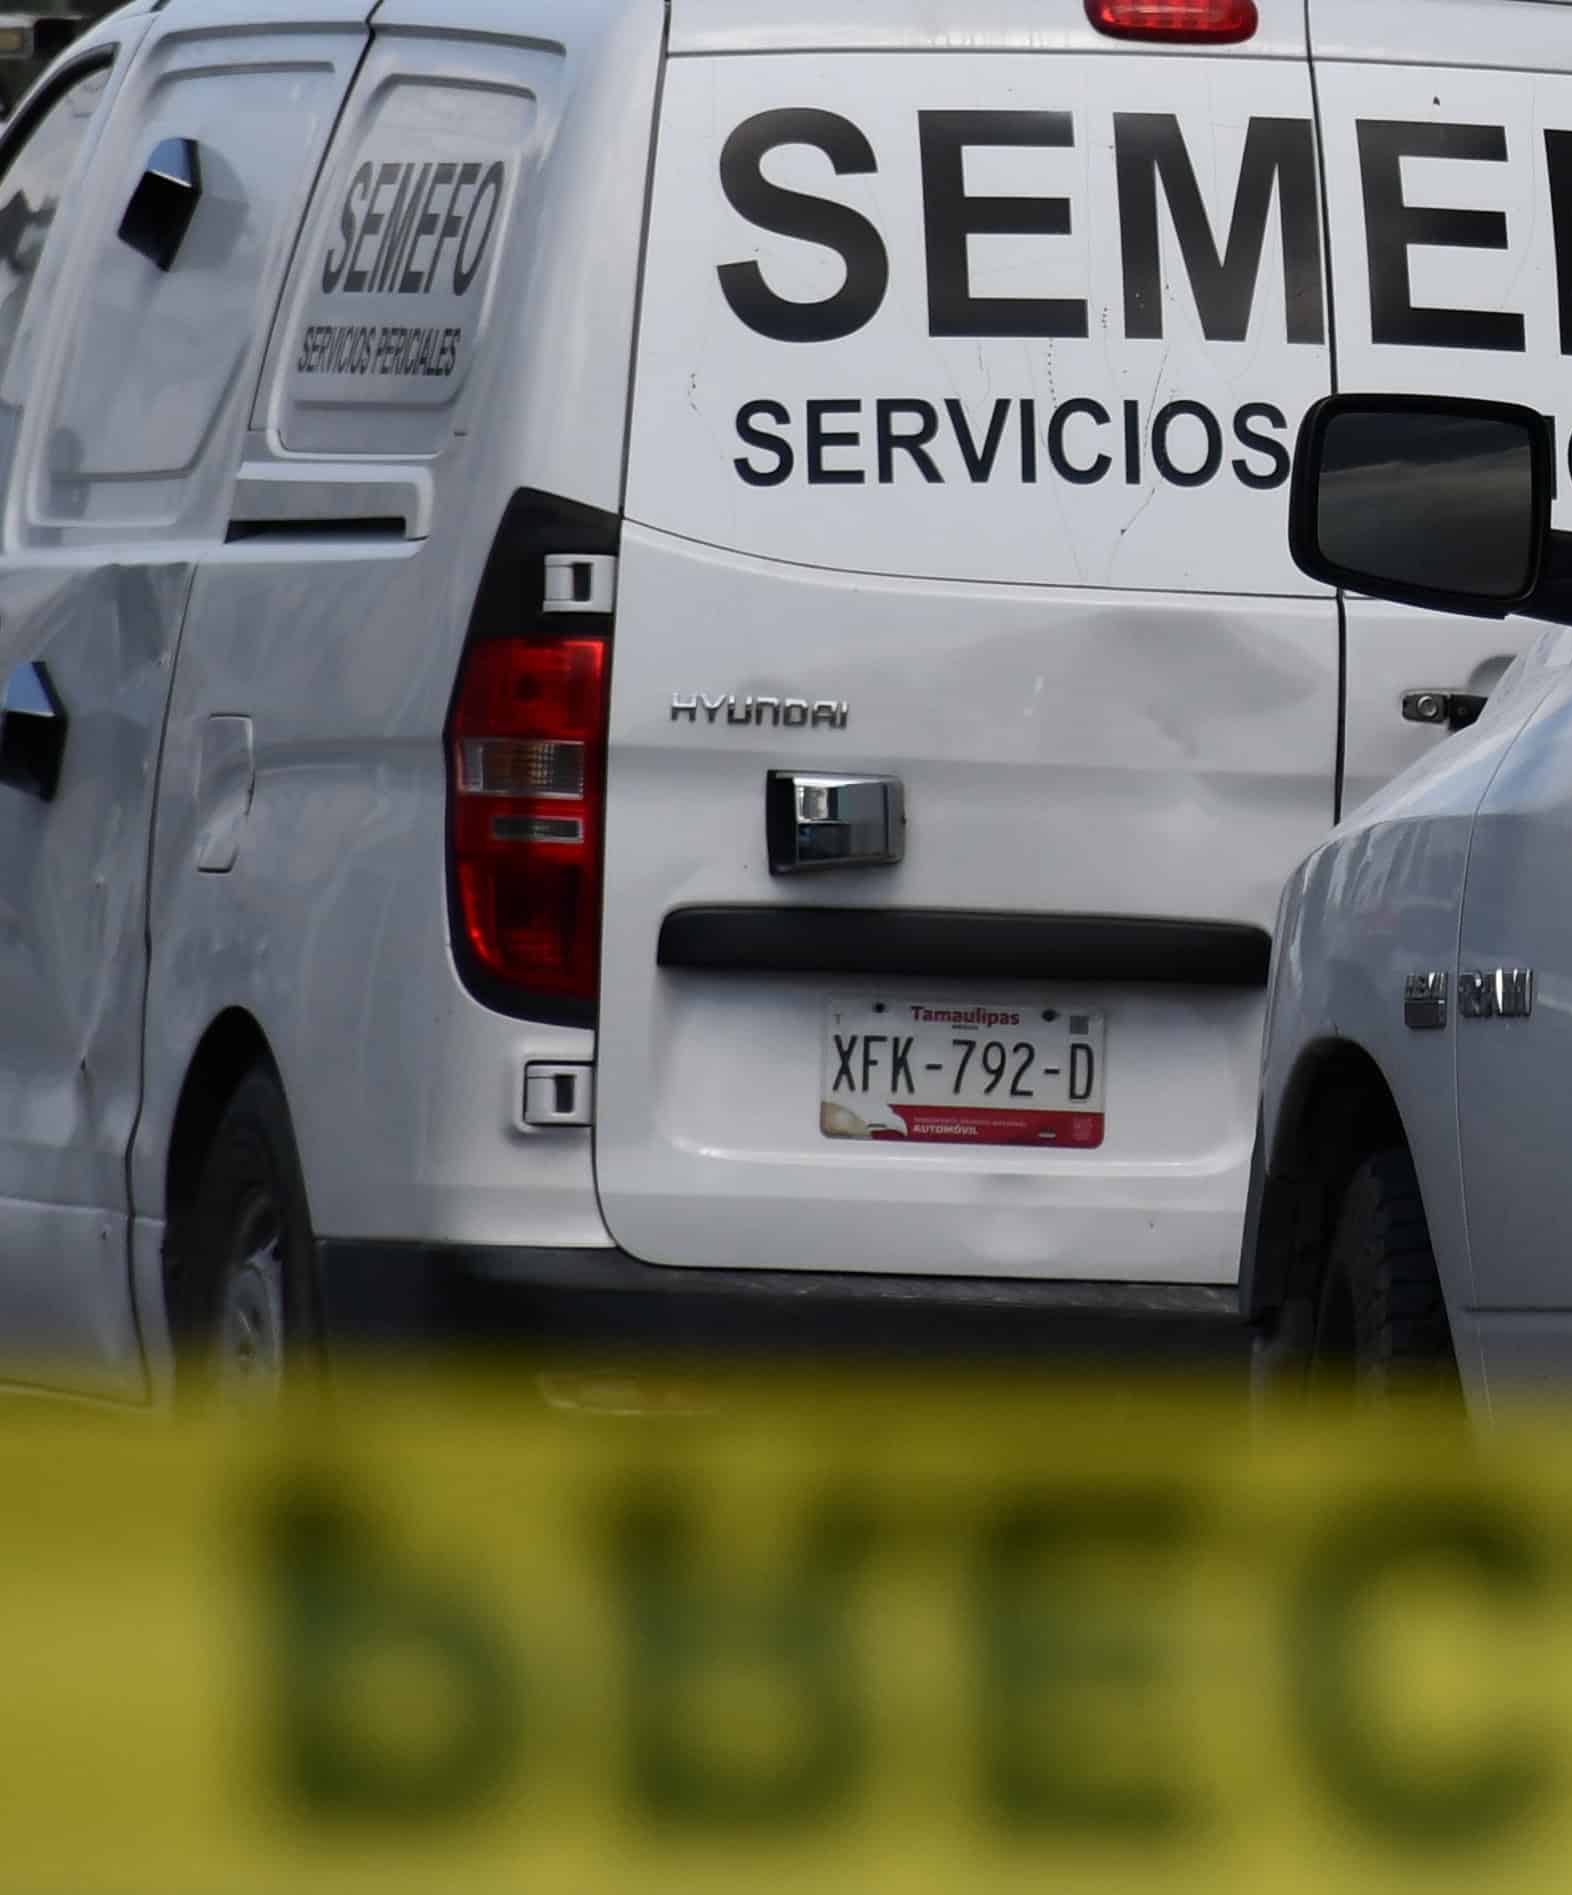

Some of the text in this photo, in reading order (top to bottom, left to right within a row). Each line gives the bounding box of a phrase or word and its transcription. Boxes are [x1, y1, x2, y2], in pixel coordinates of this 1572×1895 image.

[321, 159, 505, 297] SEMEFO
[732, 397, 1292, 491] SERVICIOS
[669, 692, 849, 730] HYUNDAI
[911, 1005, 1020, 1029] Tamaulipas
[832, 1033, 1094, 1101] XFK-792-D
